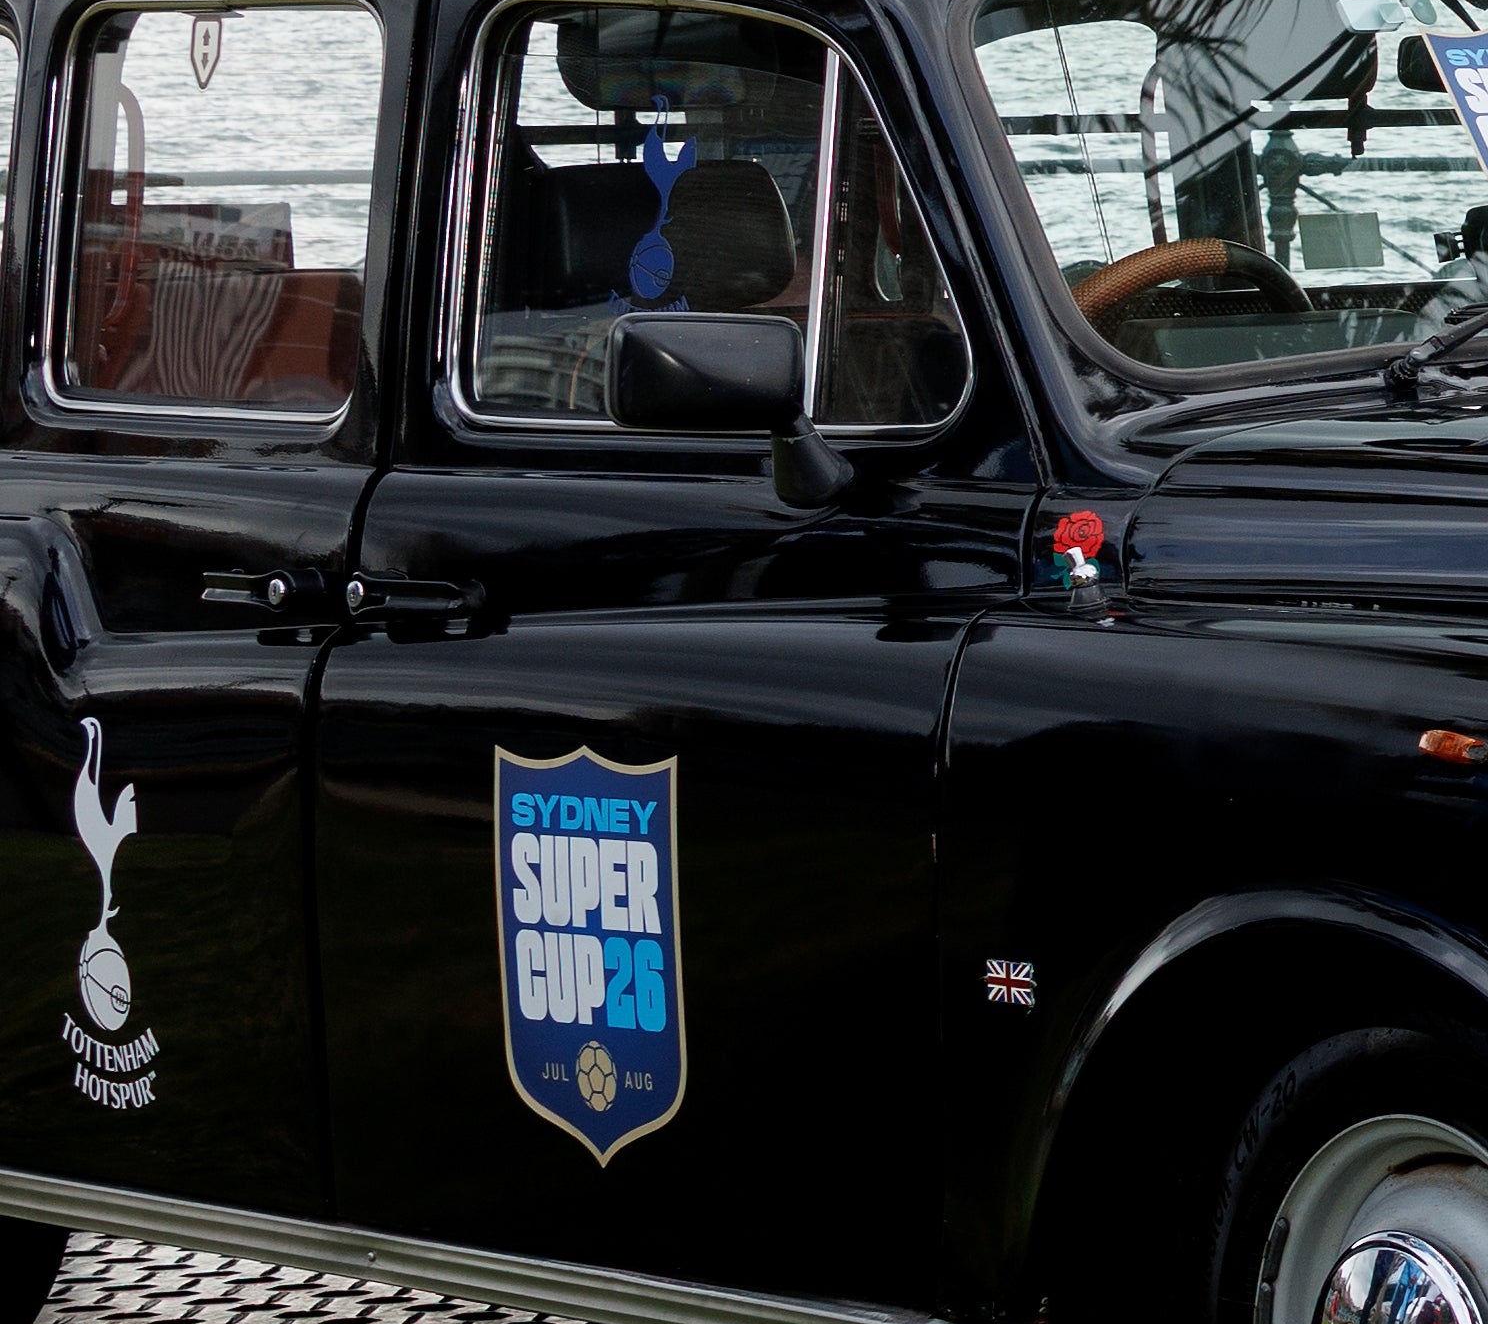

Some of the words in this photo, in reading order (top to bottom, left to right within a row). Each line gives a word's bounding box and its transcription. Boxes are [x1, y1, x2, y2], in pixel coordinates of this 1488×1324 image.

[511, 792, 658, 835] SYDNEY
[511, 832, 663, 935] SUPER
[515, 928, 667, 1033] CUP26
[62, 1012, 161, 1073] TOTTENHAM
[542, 1061, 570, 1082] JUL
[624, 1070, 654, 1092] AUG
